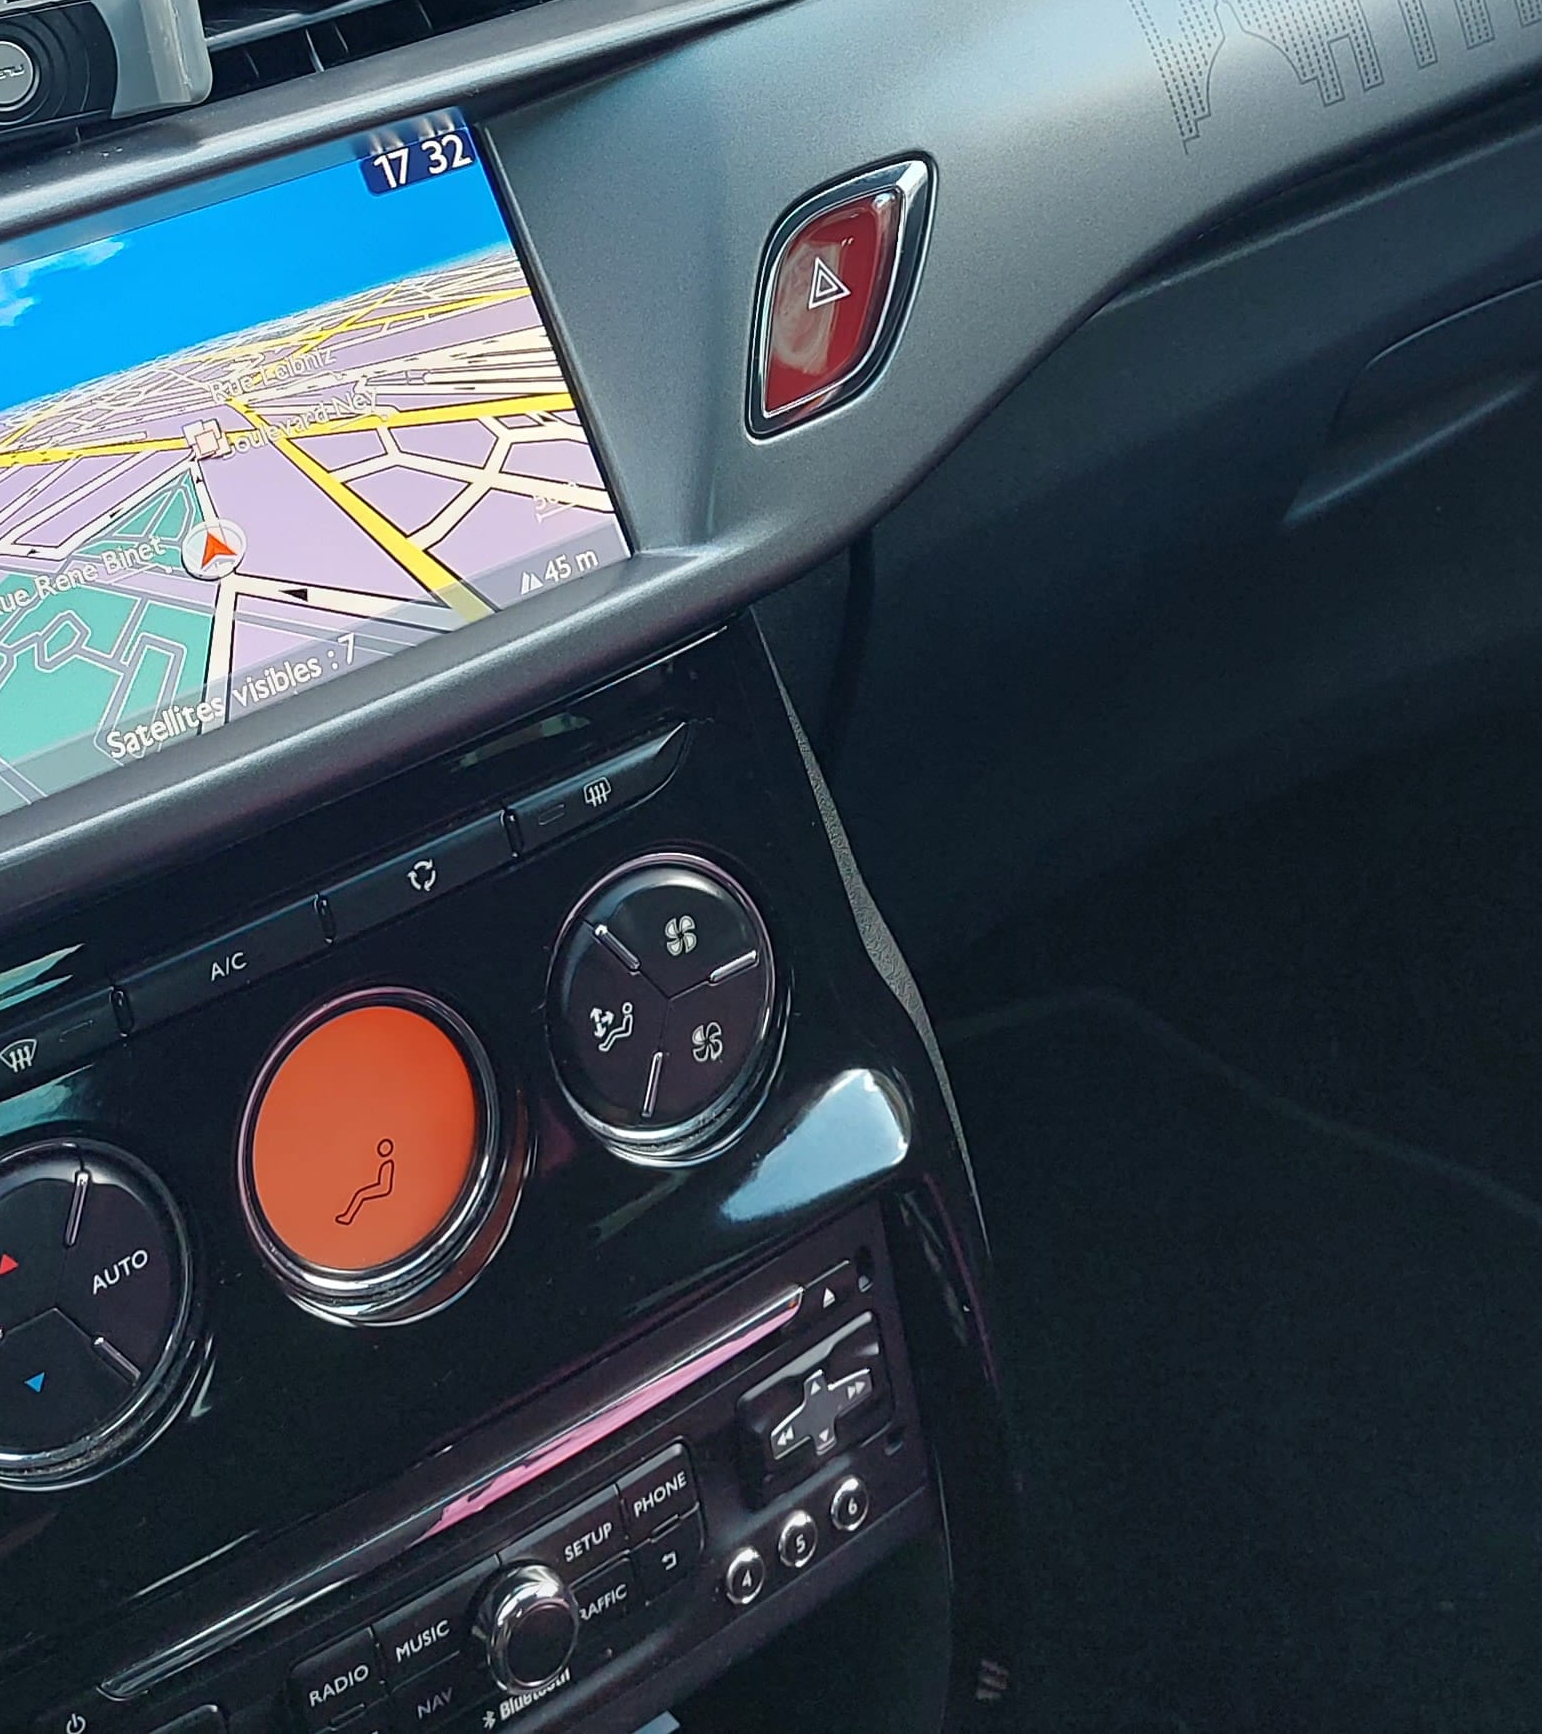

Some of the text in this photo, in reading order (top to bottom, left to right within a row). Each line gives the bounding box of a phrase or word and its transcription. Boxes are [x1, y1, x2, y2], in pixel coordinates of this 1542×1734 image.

[373, 133, 474, 189] 17 32
[210, 374, 254, 405] Rue
[224, 388, 378, 460] oulevard Ney
[34, 564, 99, 600] Rene
[100, 536, 167, 575] Binet
[544, 550, 599, 582] 45 m
[106, 696, 226, 759] Satellites
[232, 656, 323, 708] visibles
[337, 631, 356, 666] 7
[211, 952, 247, 982] A/C
[92, 1249, 149, 1296] AUTO
[633, 1469, 688, 1518] PHONE
[847, 1496, 859, 1516] 6
[563, 1521, 613, 1563] SETUP
[795, 1535, 807, 1555] 5
[741, 1569, 753, 1588] 4
[578, 1583, 628, 1621] RAFFIC
[394, 1619, 451, 1663] MUSIC
[308, 1663, 370, 1707] RADIO
[415, 1687, 455, 1719] NAV
